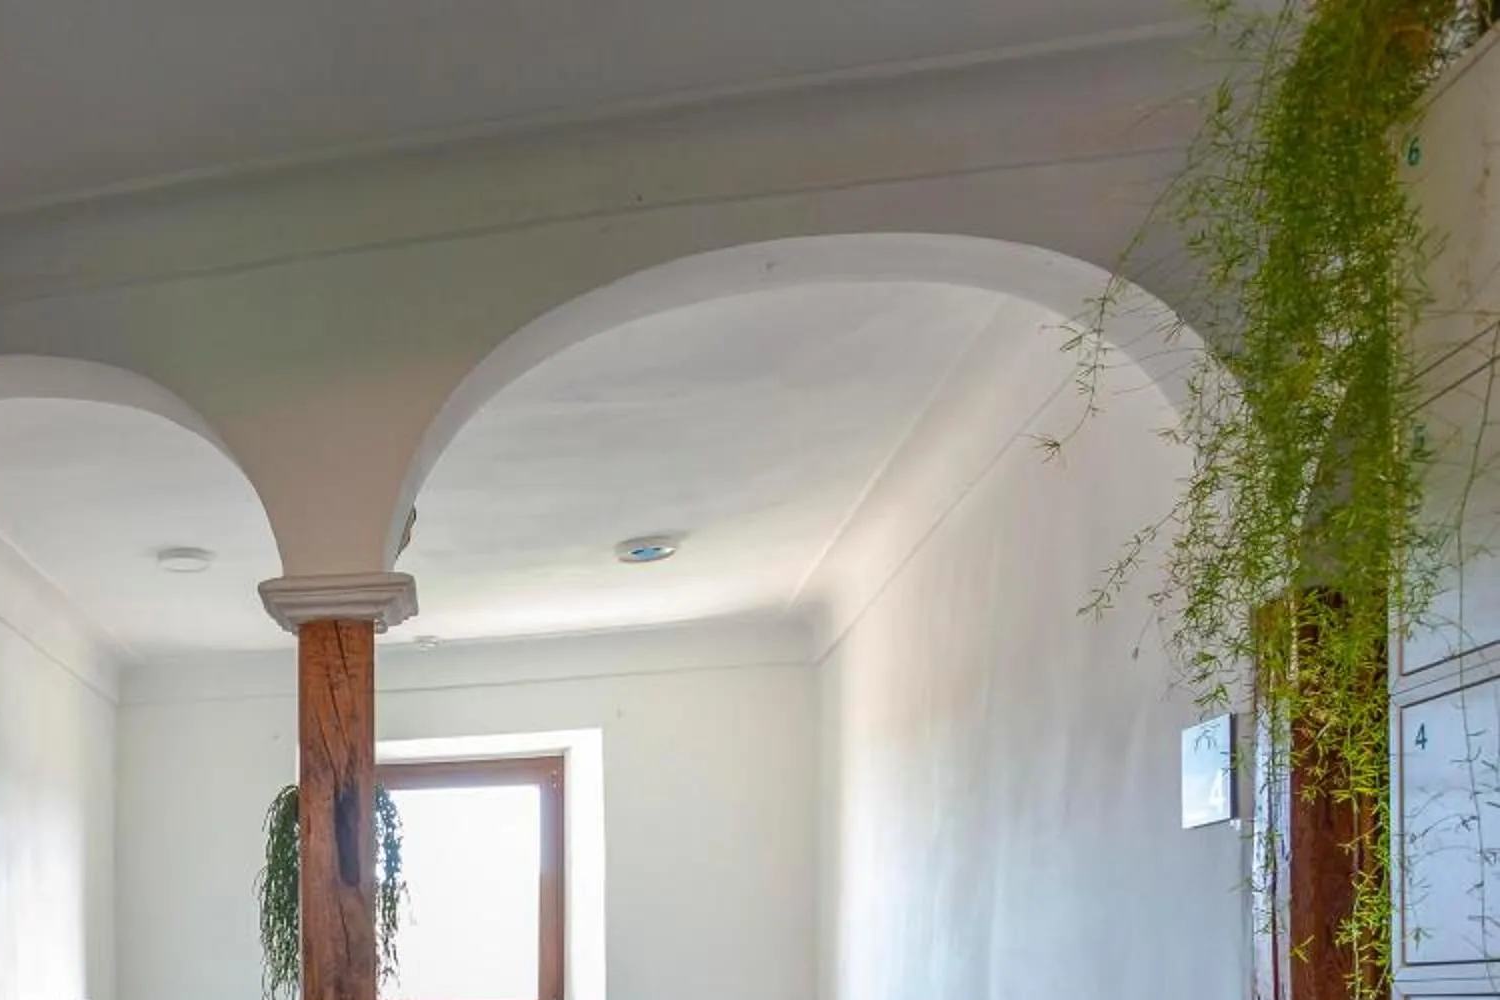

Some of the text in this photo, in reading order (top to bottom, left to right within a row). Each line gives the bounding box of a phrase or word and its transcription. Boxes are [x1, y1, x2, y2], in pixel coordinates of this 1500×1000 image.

[1407, 136, 1421, 166] 6
[1415, 723, 1427, 750] 4
[1209, 769, 1226, 814] 4
